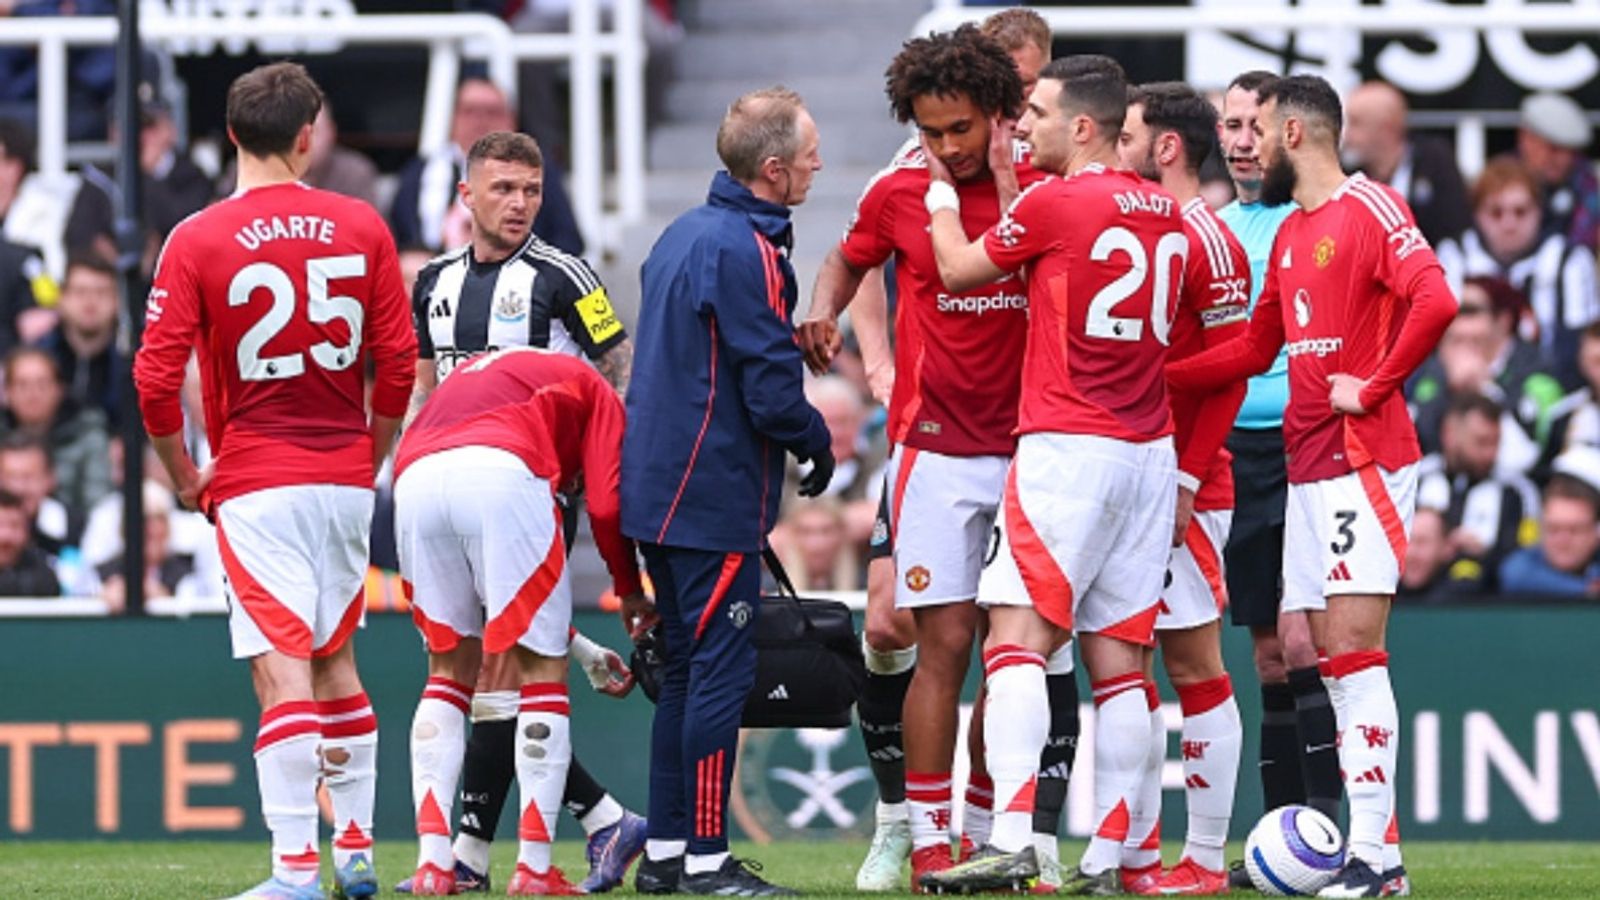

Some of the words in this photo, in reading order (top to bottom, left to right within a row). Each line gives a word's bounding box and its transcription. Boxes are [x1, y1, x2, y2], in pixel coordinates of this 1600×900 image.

[1112, 190, 1174, 217] DALOT
[234, 215, 335, 251] UGARTE
[1085, 226, 1189, 347] 20
[227, 254, 367, 381] 25
[1330, 509, 1358, 556] 3
